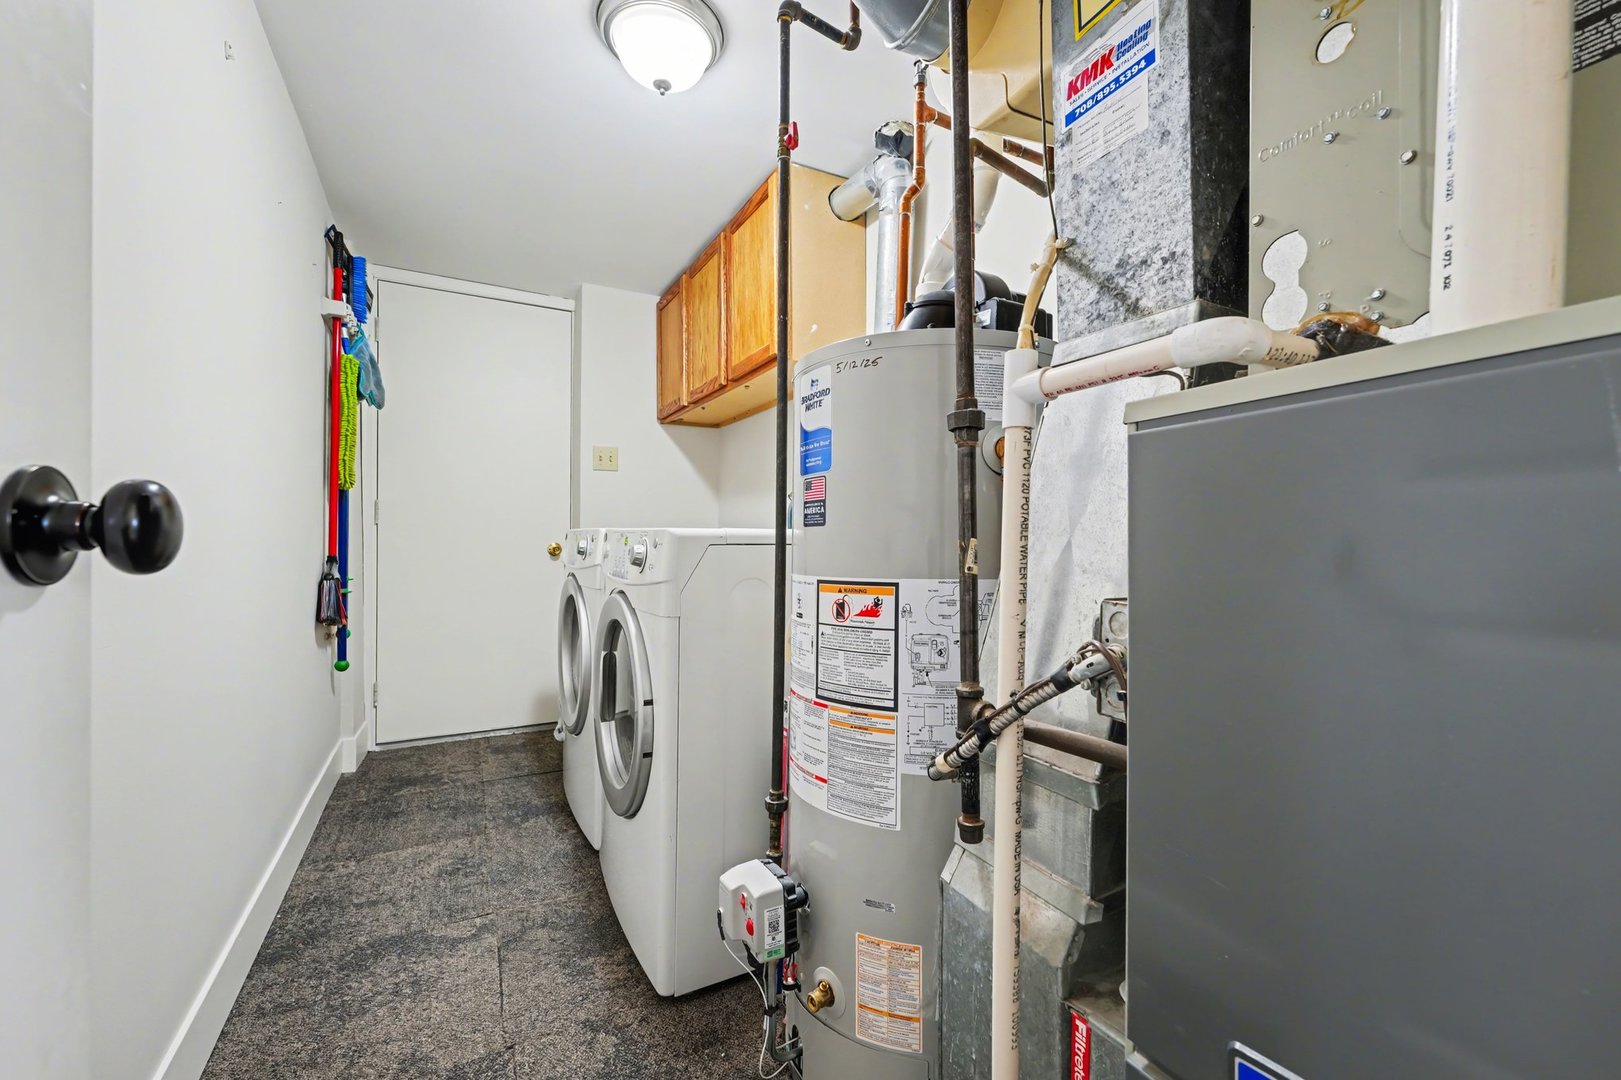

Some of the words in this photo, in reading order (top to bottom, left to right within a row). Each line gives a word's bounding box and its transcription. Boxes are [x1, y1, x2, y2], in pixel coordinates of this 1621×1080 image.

[1116, 19, 1152, 52] Heating
[1116, 31, 1149, 61] Cooling
[1066, 46, 1115, 101] KMK
[1073, 59, 1147, 118] 708/895.5394
[801, 387, 831, 407] BRADFORD
[804, 398, 825, 412] WHITE
[1022, 448, 1032, 470] PVC
[1021, 473, 1031, 495] 1120
[1020, 496, 1030, 542] POTABLE
[1018, 545, 1029, 581] WATER
[1017, 582, 1028, 605] PIPE
